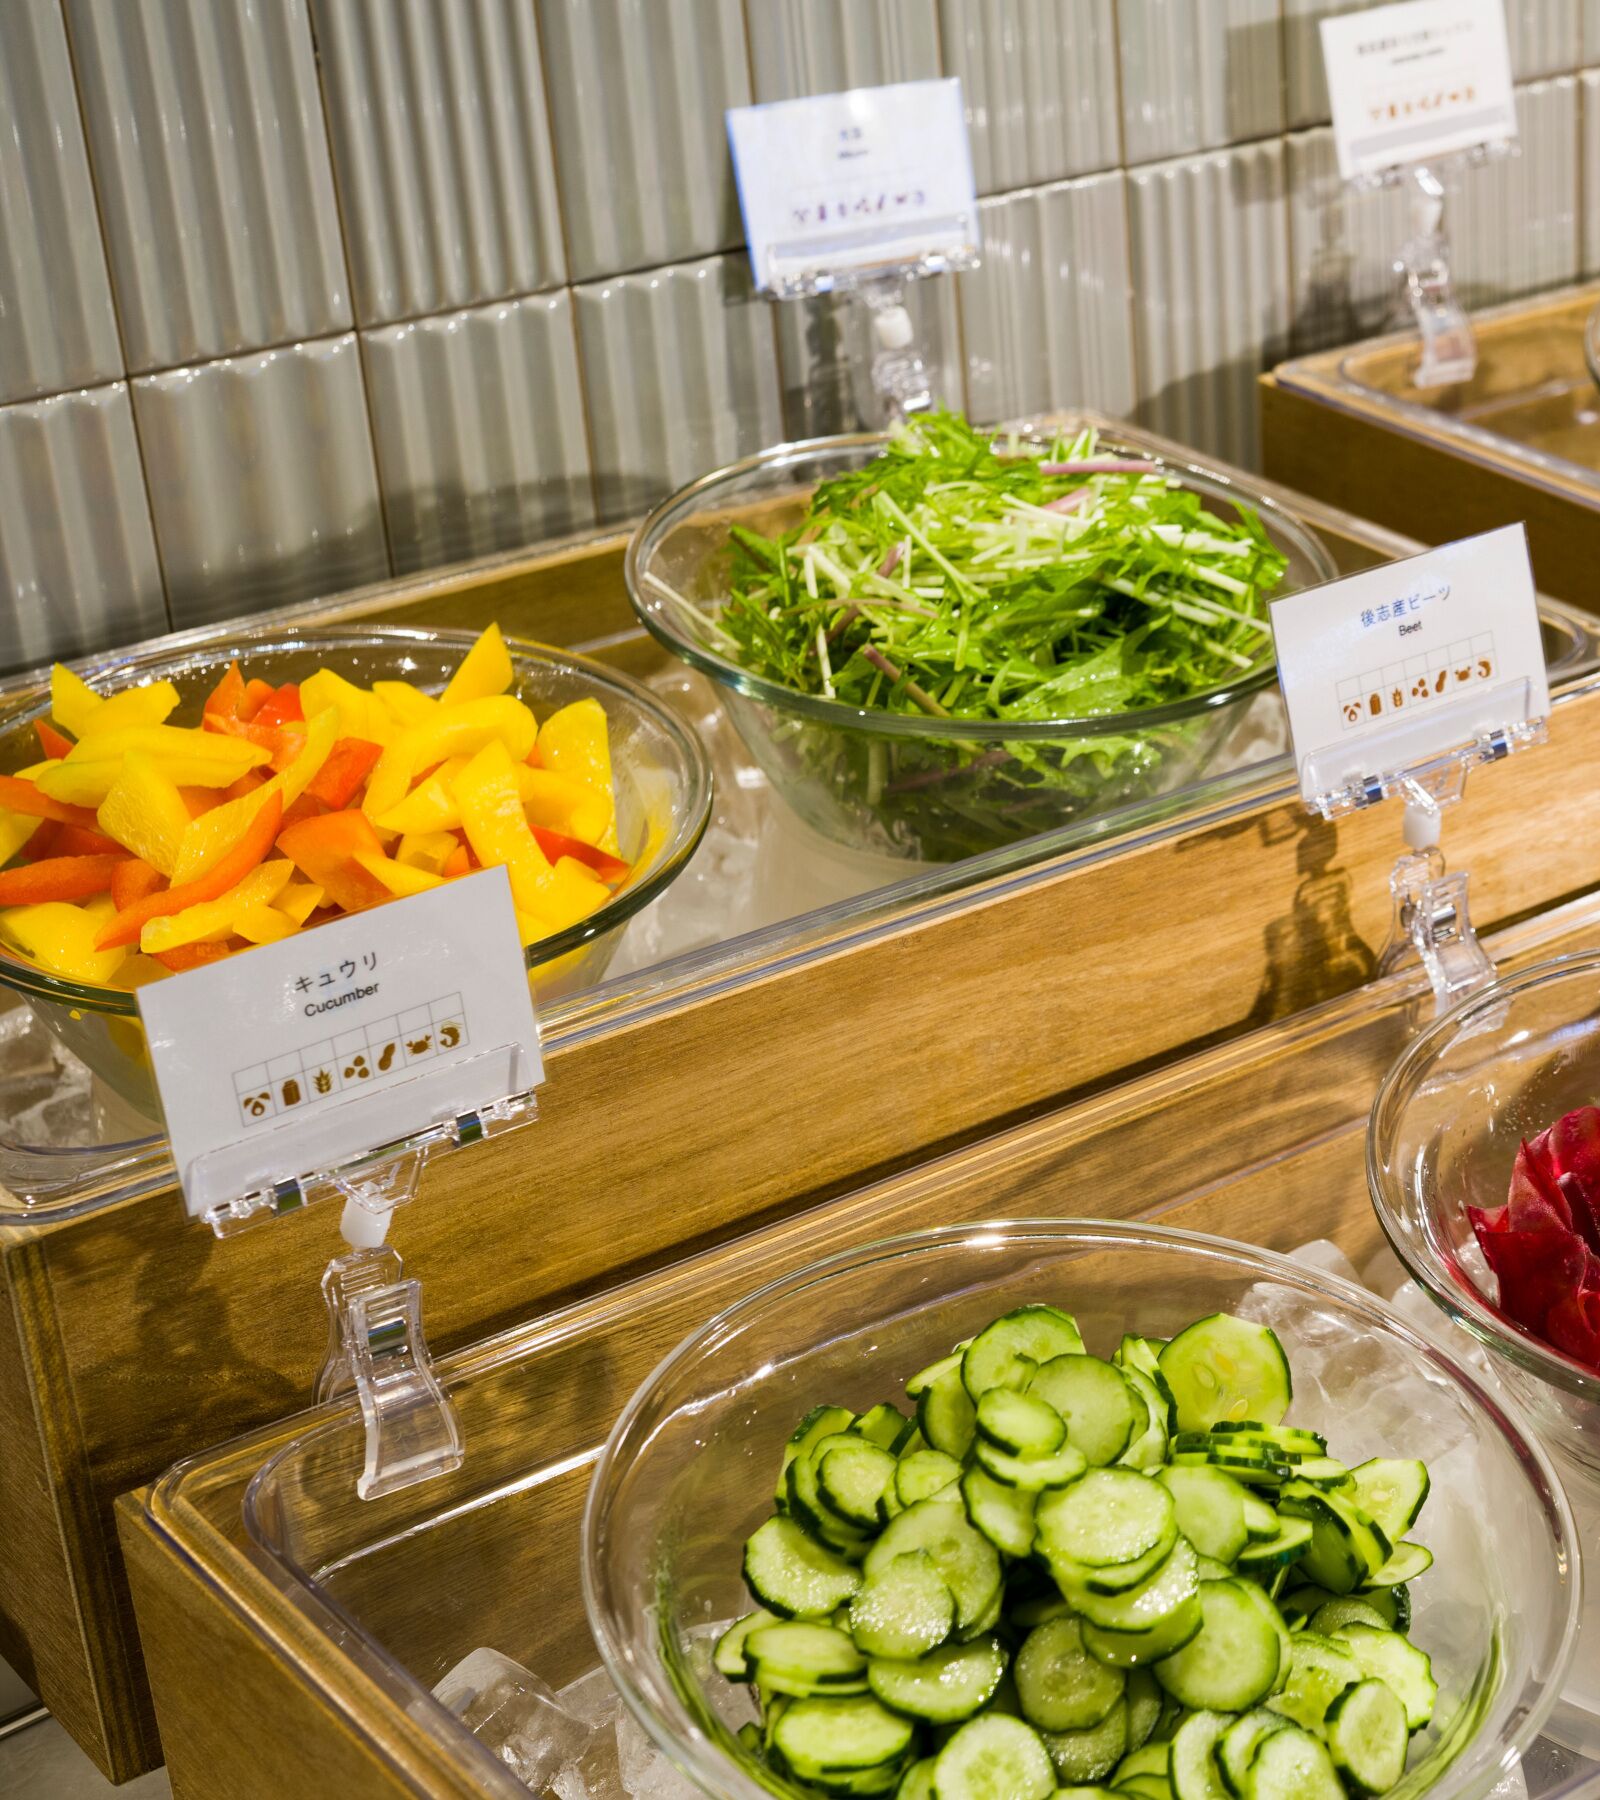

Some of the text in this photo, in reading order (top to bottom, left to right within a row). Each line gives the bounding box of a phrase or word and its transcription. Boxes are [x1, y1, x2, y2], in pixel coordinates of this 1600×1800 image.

[1360, 584, 1451, 628] 後志産ビーツ
[1398, 620, 1423, 637] Beet
[295, 951, 377, 994] キュウリ
[304, 982, 379, 1017] Cucumber
